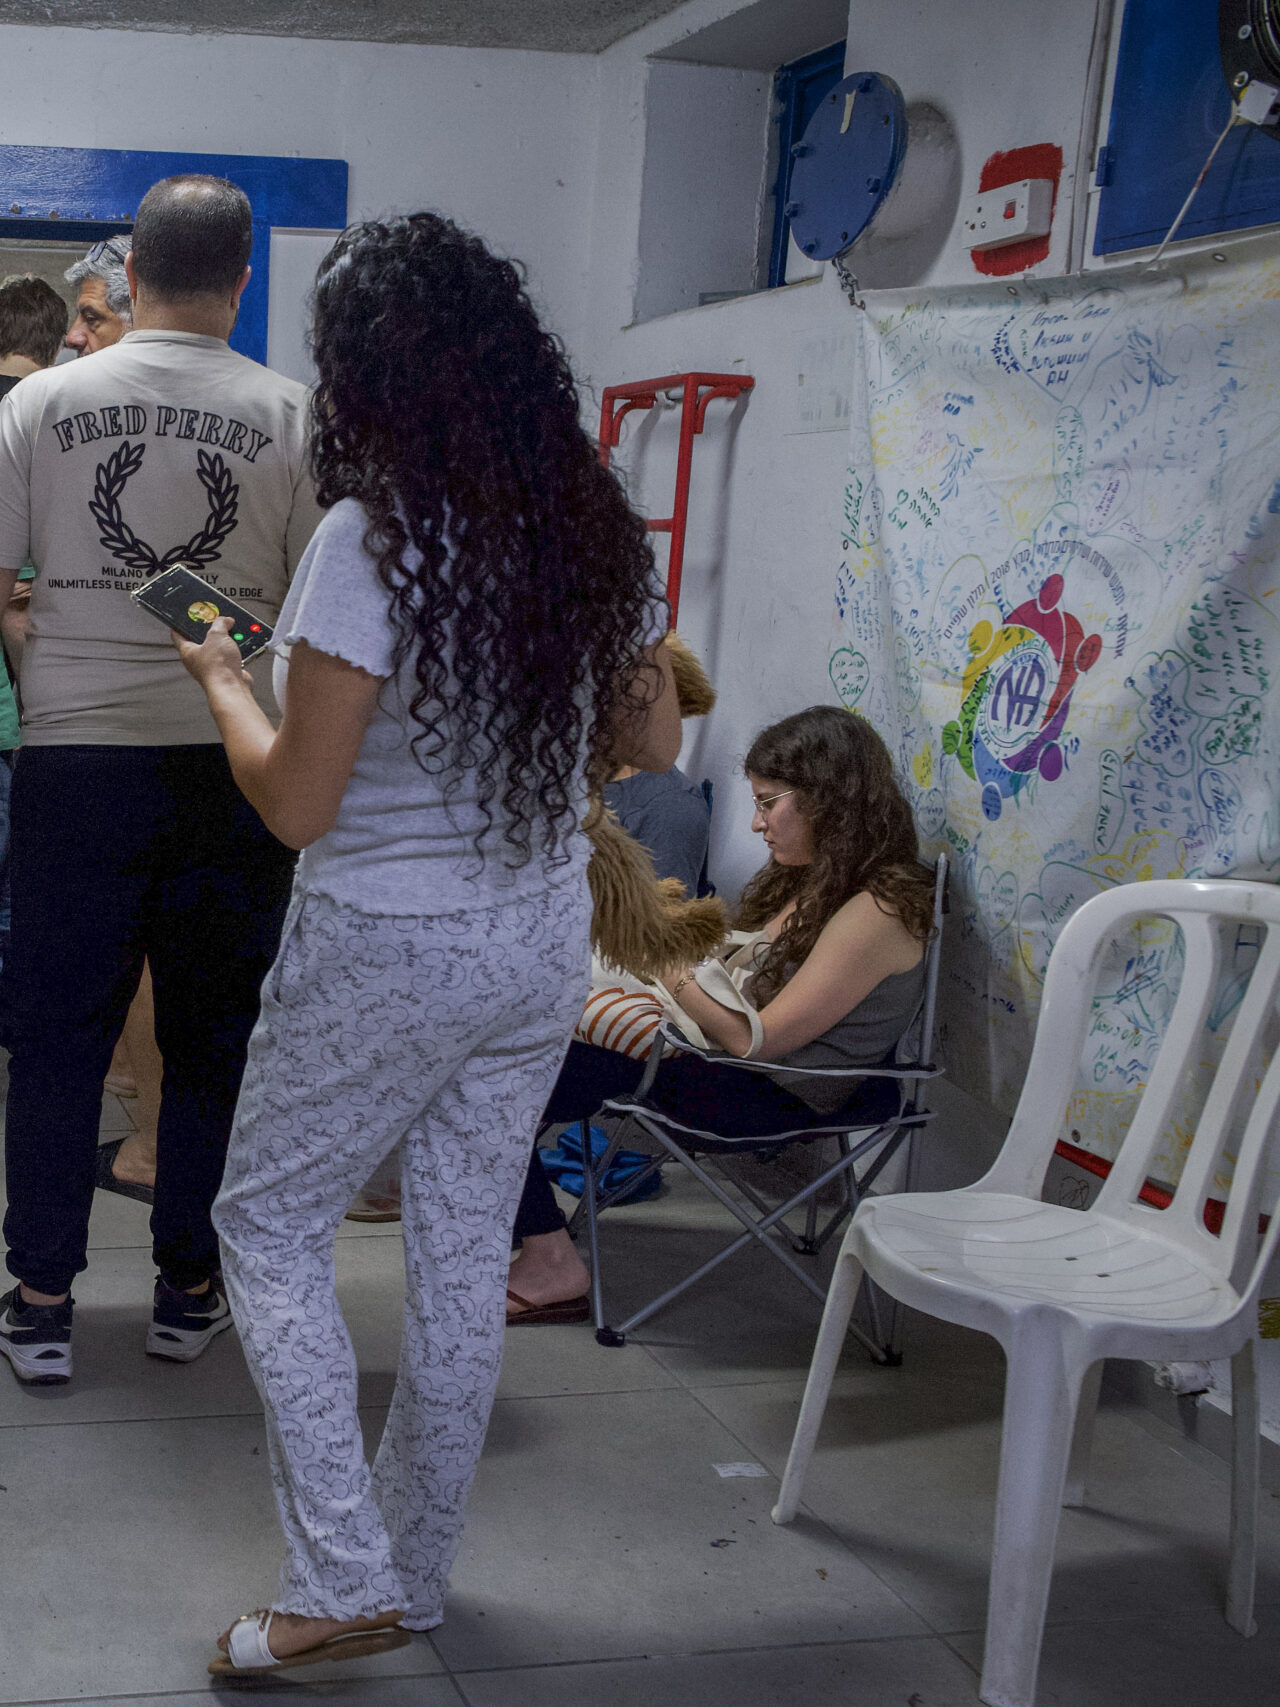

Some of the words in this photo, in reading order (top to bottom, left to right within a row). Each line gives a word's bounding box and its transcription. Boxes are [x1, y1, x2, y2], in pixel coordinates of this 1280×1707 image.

[52, 405, 147, 452] FRED
[156, 405, 273, 463] PERRY
[102, 566, 143, 578] MILANO
[990, 560, 1010, 584] 2018
[48, 579, 112, 590] UNLMITLESS
[218, 588, 236, 598] OLD
[240, 588, 263, 598] EDGE
